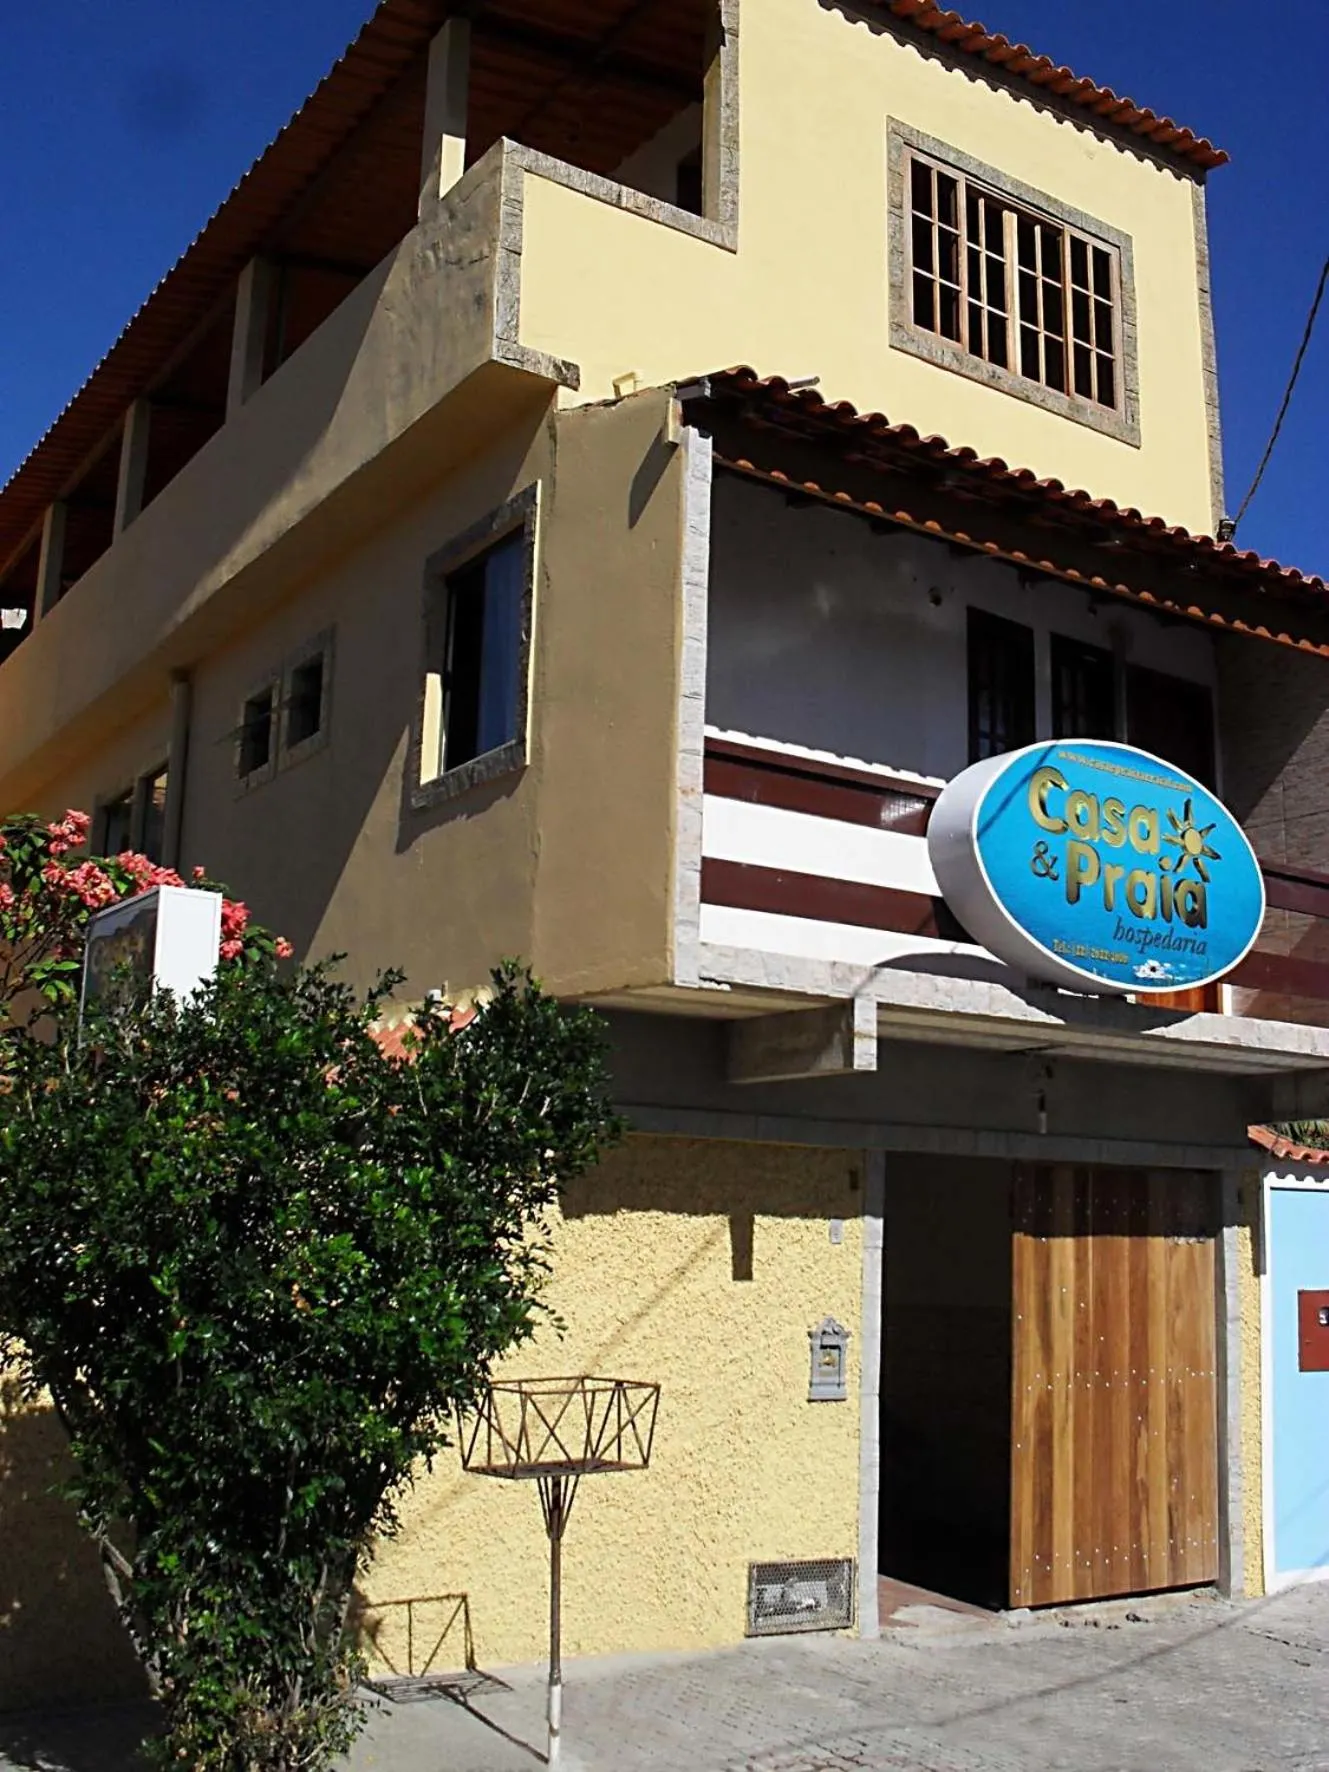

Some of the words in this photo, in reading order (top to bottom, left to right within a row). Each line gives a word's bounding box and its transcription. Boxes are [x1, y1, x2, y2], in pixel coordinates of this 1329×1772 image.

[1029, 766, 1160, 855] Casa
[1031, 840, 1059, 881] &
[1066, 839, 1208, 930] Praia
[1113, 917, 1208, 956] hospedaria
